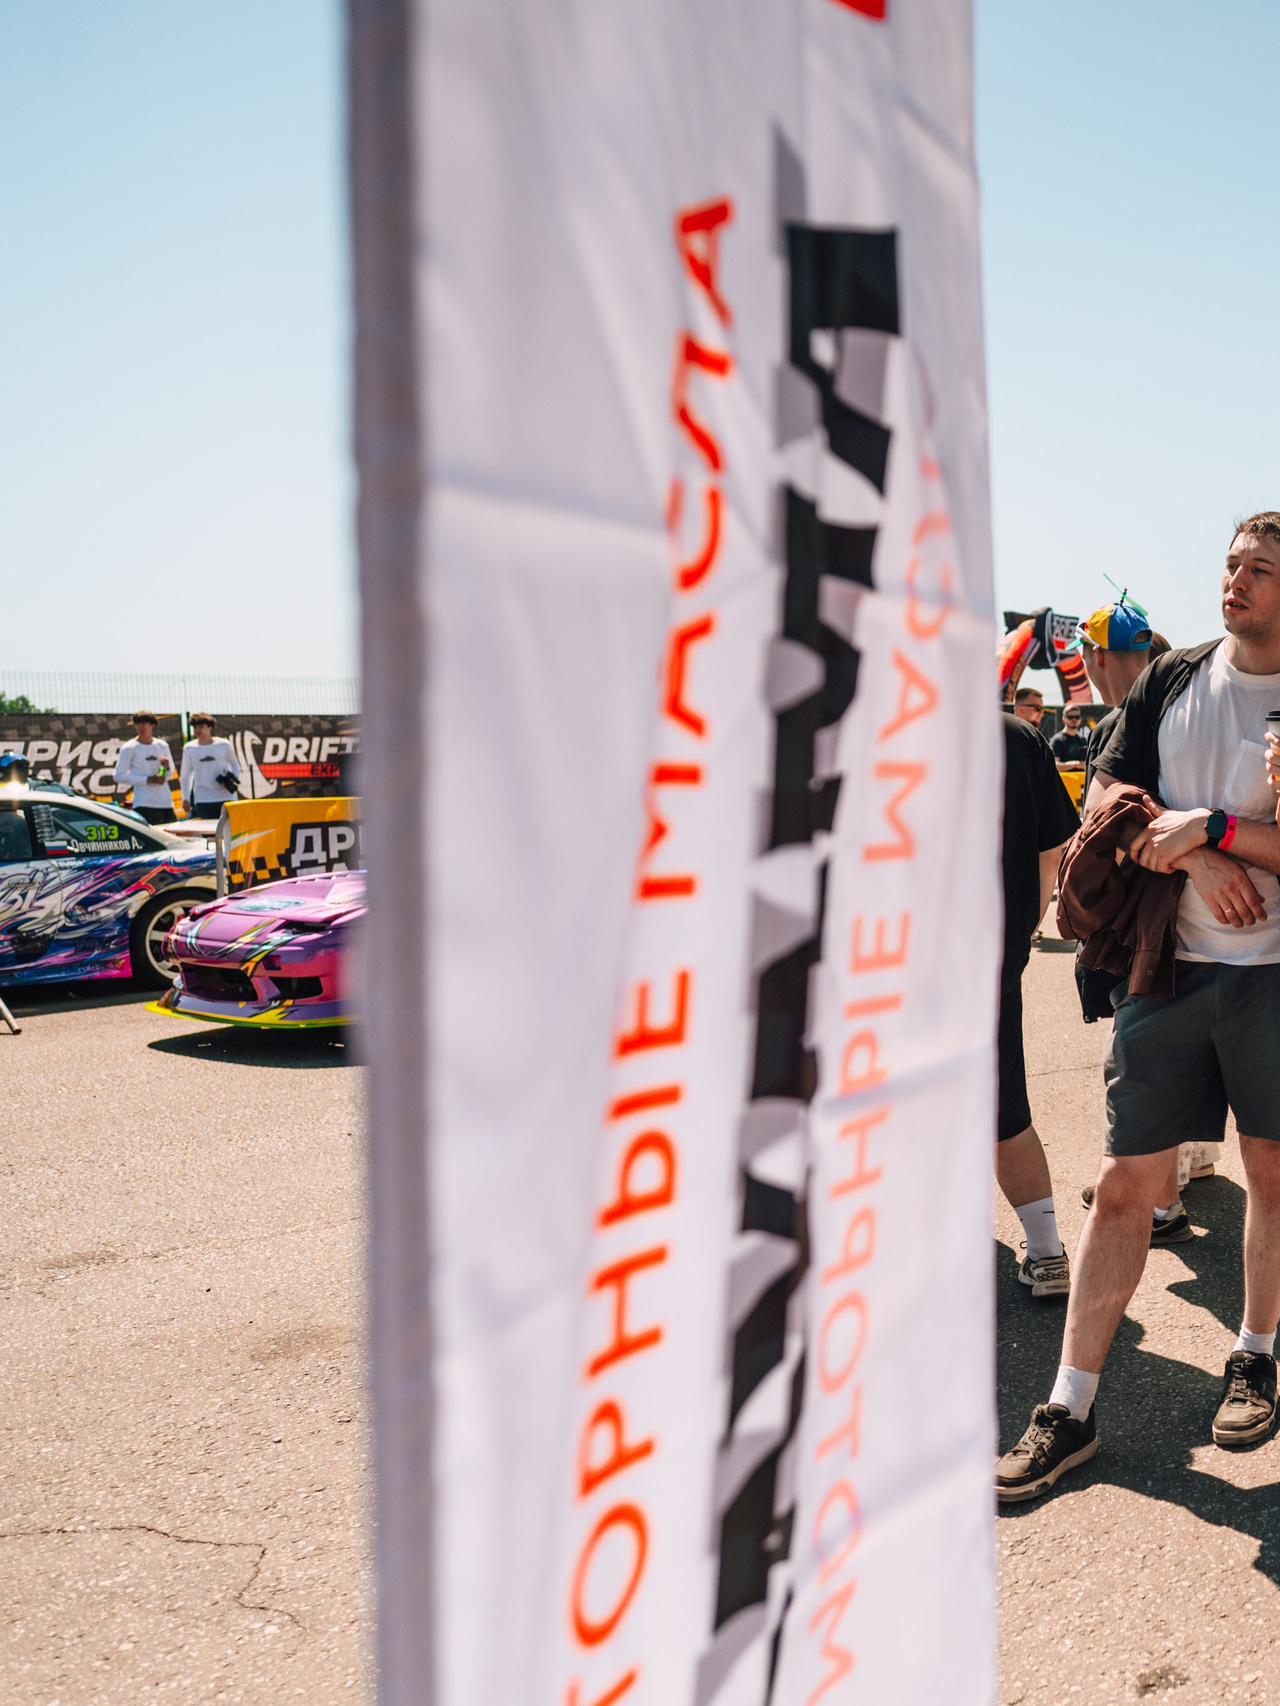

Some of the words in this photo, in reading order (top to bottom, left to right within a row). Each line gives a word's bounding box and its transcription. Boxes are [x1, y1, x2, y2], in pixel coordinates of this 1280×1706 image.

[0, 738, 124, 767] РИФ
[311, 763, 341, 776] EXP
[85, 825, 119, 840] 313
[291, 824, 362, 868] ДР
